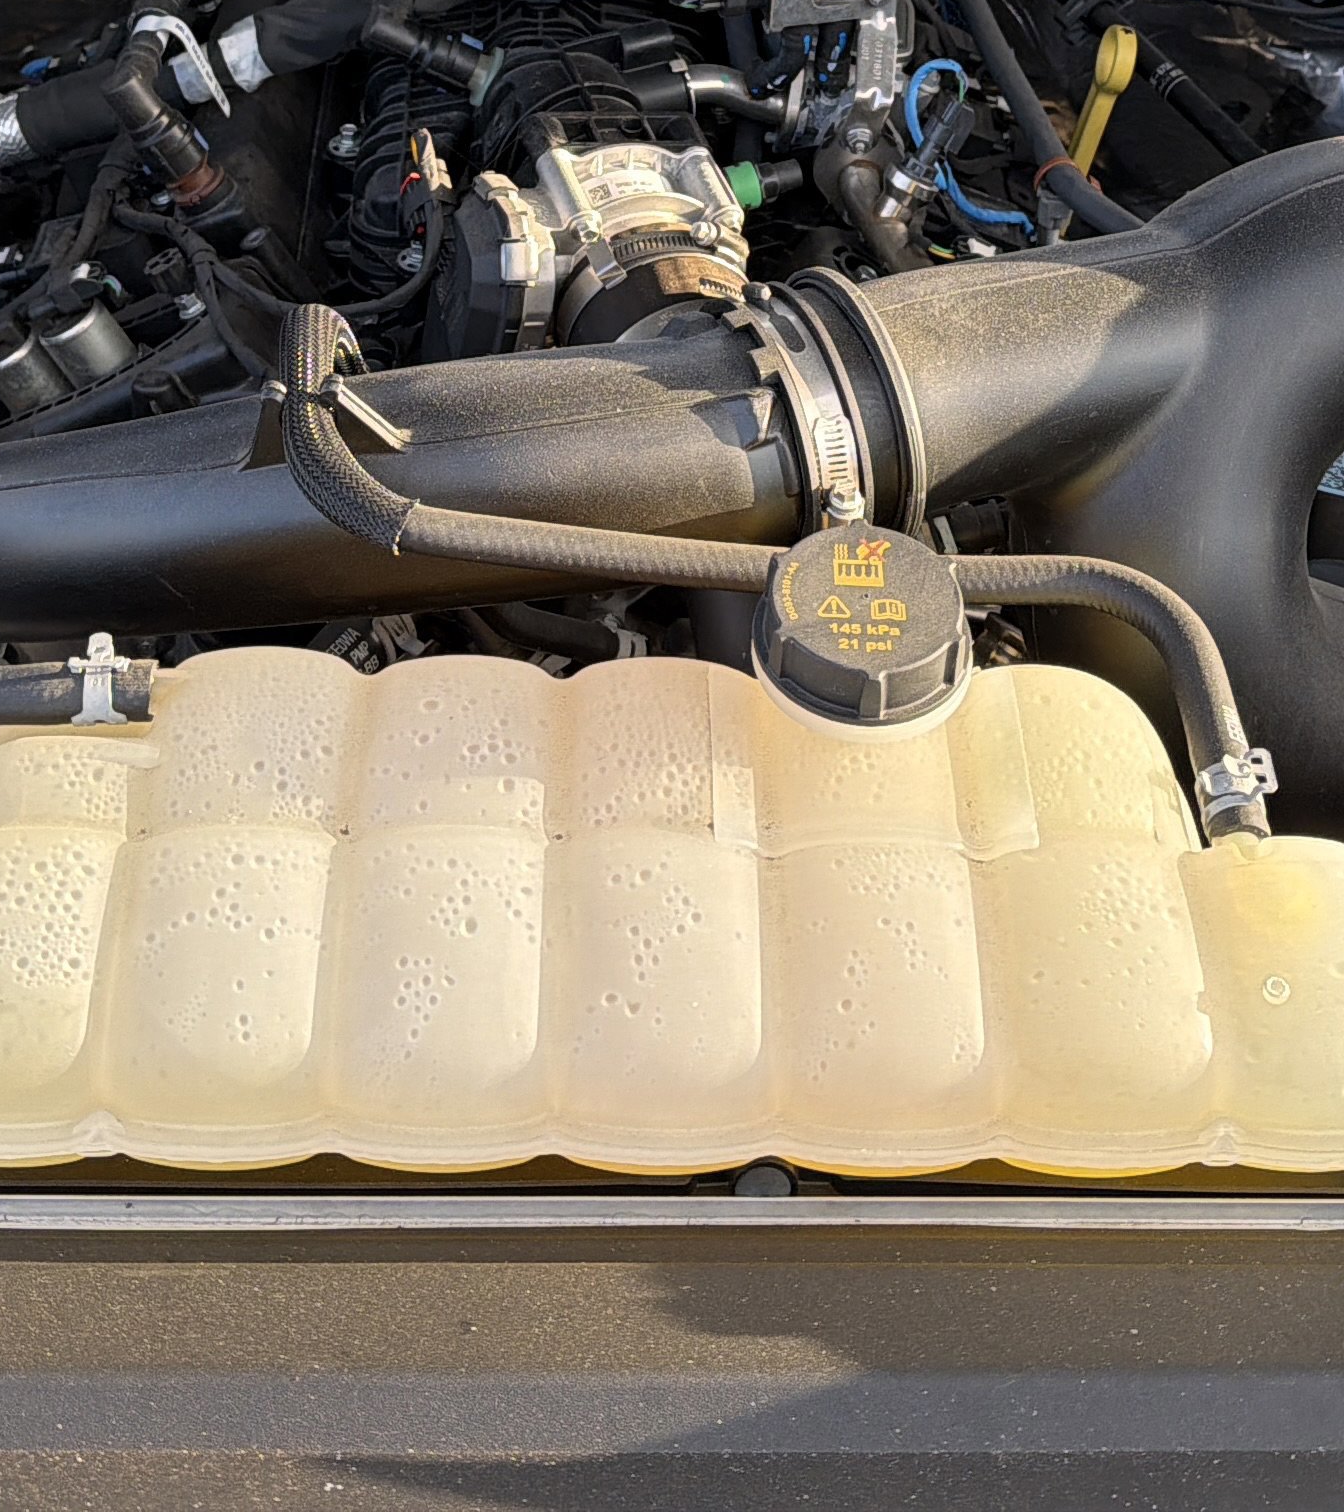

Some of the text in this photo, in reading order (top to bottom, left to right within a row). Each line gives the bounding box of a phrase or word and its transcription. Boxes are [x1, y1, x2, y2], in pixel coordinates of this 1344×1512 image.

[829, 622, 901, 636] 145 kPa
[349, 640, 370, 665] PMP
[837, 638, 893, 653] 21 psi
